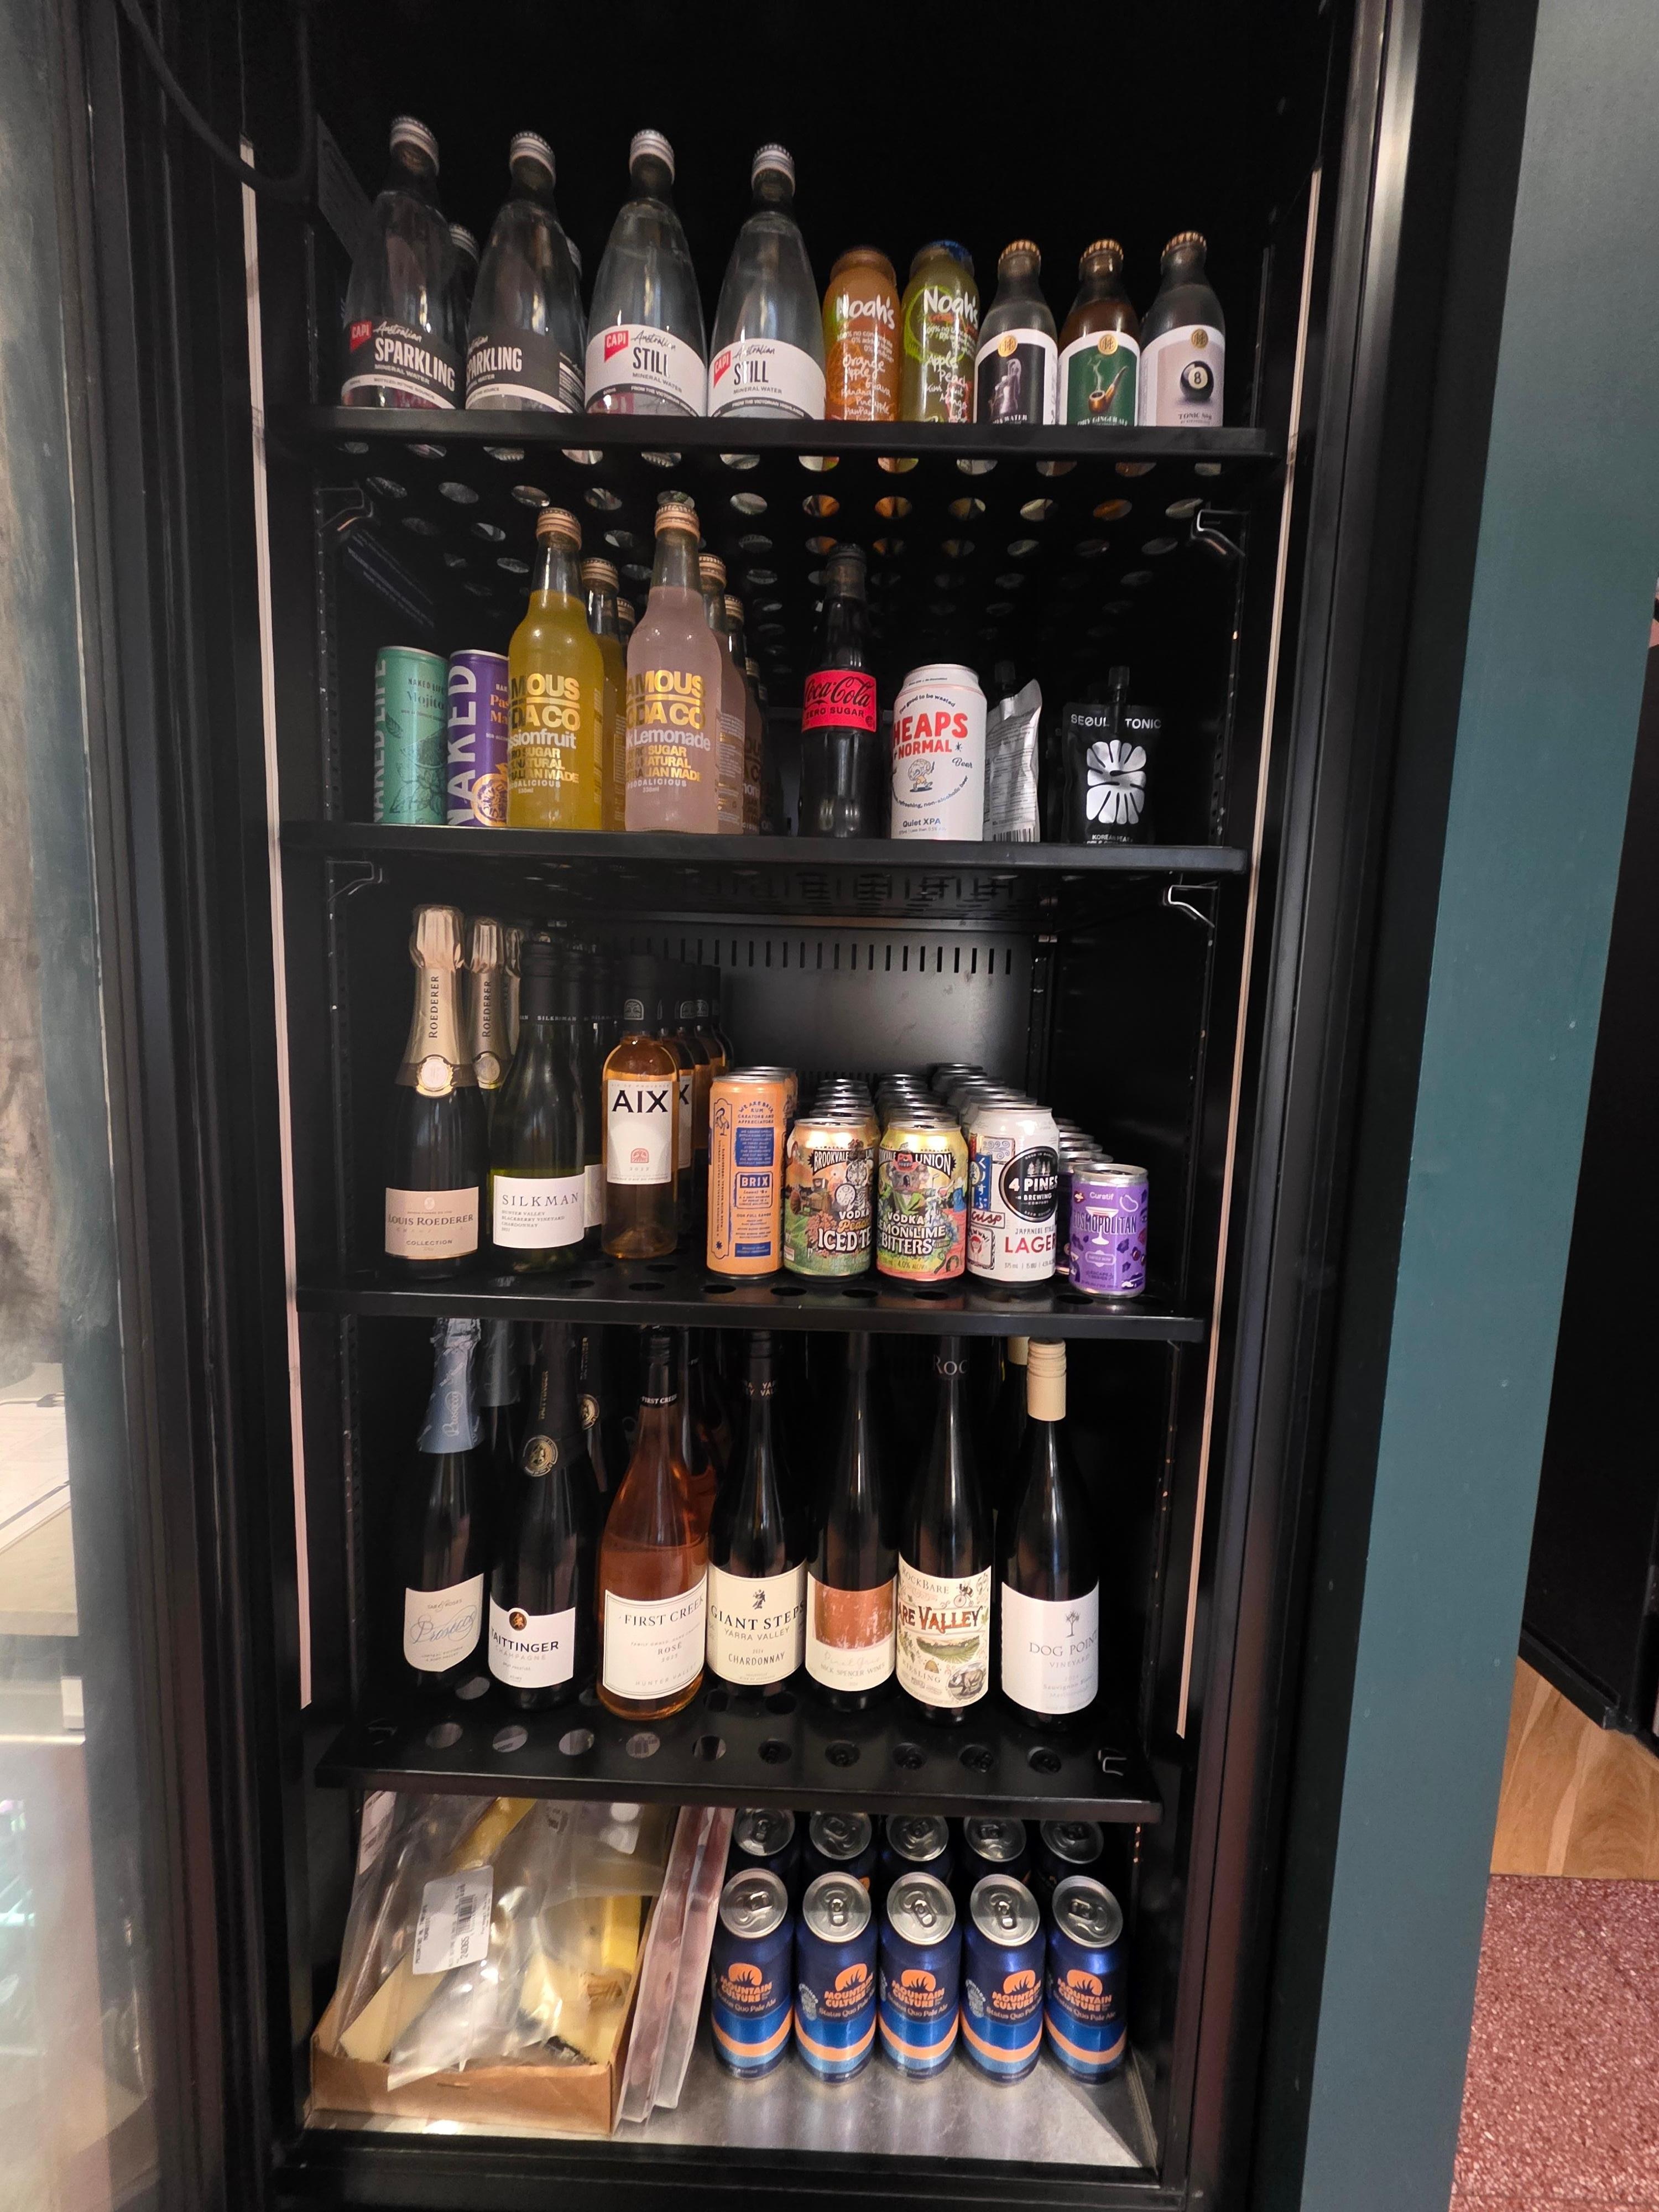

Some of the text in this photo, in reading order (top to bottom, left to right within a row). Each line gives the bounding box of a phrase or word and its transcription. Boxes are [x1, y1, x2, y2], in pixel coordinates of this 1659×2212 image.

[836, 293, 895, 330] Noah's
[924, 285, 978, 331] Noah's
[607, 333, 626, 349] CAPI
[375, 337, 455, 392] SPARKLING
[714, 352, 729, 374] CAPI
[843, 353, 885, 381] Orange
[926, 350, 959, 372] Apple
[632, 373, 682, 393] MINERAL WATER
[1193, 371, 1202, 384] 8
[733, 386, 760, 395] MINERAL
[805, 676, 874, 711] Coca-Cola
[935, 695, 956, 708] wasted
[542, 705, 581, 731] CO
[669, 702, 706, 730] CO
[830, 707, 864, 718] SUGAR
[894, 712, 968, 749] HEAPS
[1125, 718, 1162, 731] TONIC
[634, 728, 711, 752] Lemonade
[897, 739, 953, 760] NORMAL
[648, 745, 687, 757] SUGAR
[952, 757, 973, 769] Beer
[545, 769, 579, 784] MADE
[902, 820, 921, 828] Quiet
[428, 975, 440, 1039] ROEDERER
[482, 980, 492, 1038] ROEDERER
[612, 1089, 669, 1113] AIX
[813, 1151, 849, 1172] BROOKVALE
[915, 1154, 951, 1176] UNION
[742, 1176, 768, 1187] BRIX
[1009, 1175, 1058, 1192] 4 PINES
[502, 1192, 578, 1207] SILKMAN
[1024, 1193, 1052, 1201] BREWING
[1089, 1191, 1115, 1201] Curatif
[388, 1214, 473, 1226] LOUIS ROEDERER
[839, 1209, 870, 1220] VODKA
[888, 1212, 925, 1225] VODKA
[1073, 1211, 1137, 1235] COSMOPOLITAN
[818, 1228, 858, 1251] ICED
[914, 1225, 946, 1239] LIME
[1005, 1232, 1056, 1254] LAGER
[641, 1396, 659, 1405] FIRST
[902, 1566, 950, 1595] ROCKBARE
[624, 1595, 704, 1627] FIRST CREEK
[711, 1600, 805, 1631] GIANT STEPS
[918, 1605, 983, 1635] VALLEY
[410, 1604, 477, 1645] Prosecco
[724, 1626, 790, 1641] YARRA VALLEY
[492, 1628, 559, 1653] TAITTINGER
[1029, 1642, 1063, 1657] DOG
[728, 1651, 785, 1666] CHARDONNAY
[1050, 1654, 1090, 1668] VINEYARD
[635, 1677, 670, 1687] HUNTER
[721, 1975, 773, 1995] MOUNTAIN
[721, 1985, 761, 2003] CULTURE
[891, 1980, 945, 2000] MOUNTAIN
[1057, 1978, 1112, 2004] MOUNTAIN
[826, 1989, 866, 2008] CULTURE
[893, 1988, 934, 2008] CULTURE
[993, 1996, 1034, 2010] CULTURE
[1058, 1987, 1101, 2012] CULTURE
[734, 2004, 750, 2012] Quo
[842, 2008, 857, 2018] Quo
[907, 2007, 922, 2017] Quo
[987, 2006, 1025, 2020] Status Quo
[1073, 2008, 1089, 2020] Quo
